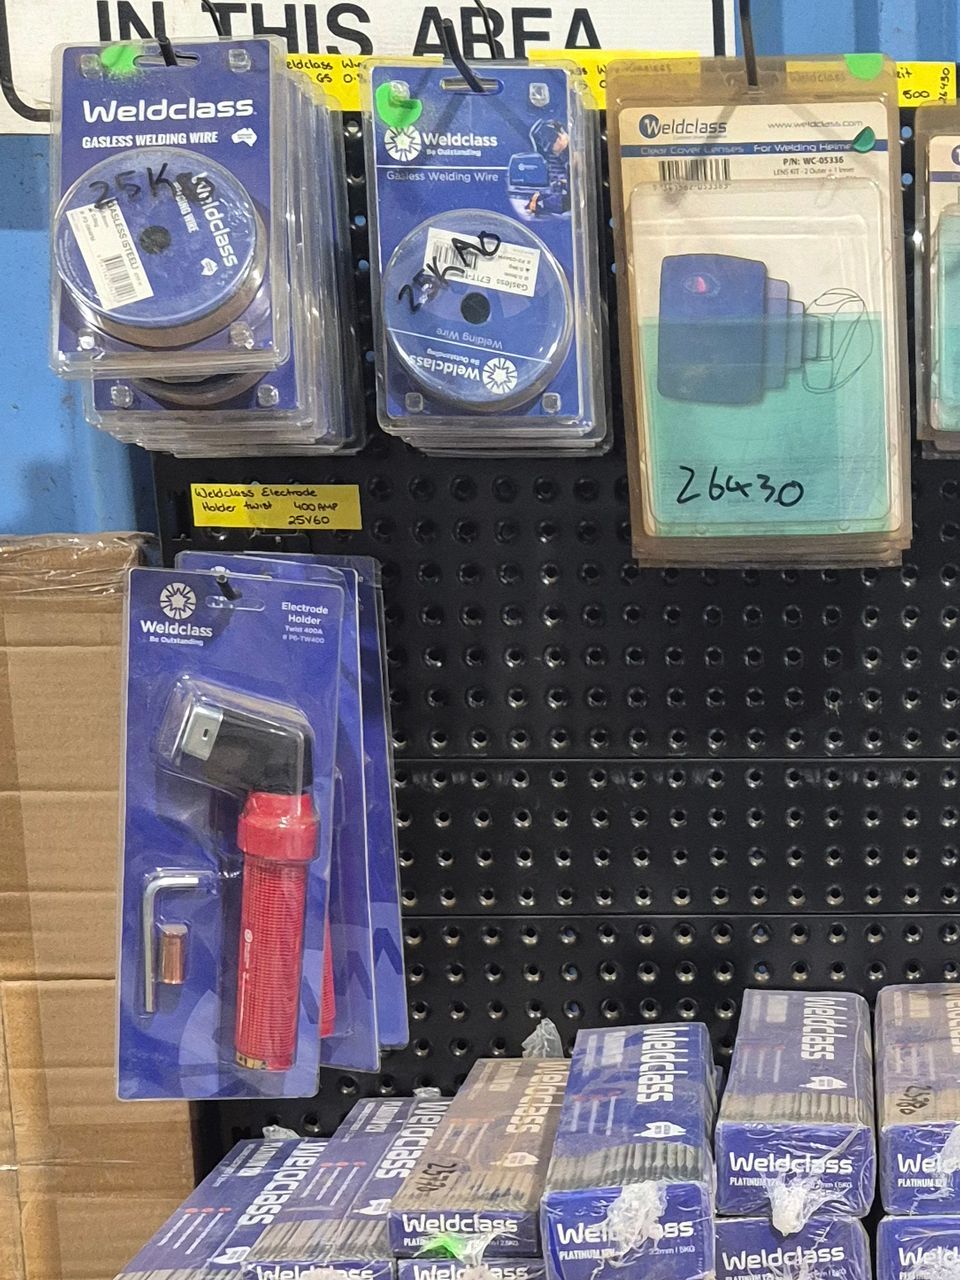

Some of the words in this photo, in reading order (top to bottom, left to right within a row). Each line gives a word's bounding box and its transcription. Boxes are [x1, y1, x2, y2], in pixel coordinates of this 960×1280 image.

[82, 98, 255, 123] Weldclass
[640, 114, 727, 138] Weldclass
[82, 134, 133, 149] GASLESS
[135, 133, 188, 146] WELDING
[190, 132, 218, 144] WIRE
[422, 132, 498, 148] Weldclass
[428, 171, 471, 182] Welding
[474, 171, 499, 181] Wire
[676, 465, 804, 506] 26430
[281, 602, 329, 614] Electrode
[288, 614, 322, 625] Holder
[140, 620, 213, 638] Weldclass
[402, 1213, 518, 1233] Weldclass
